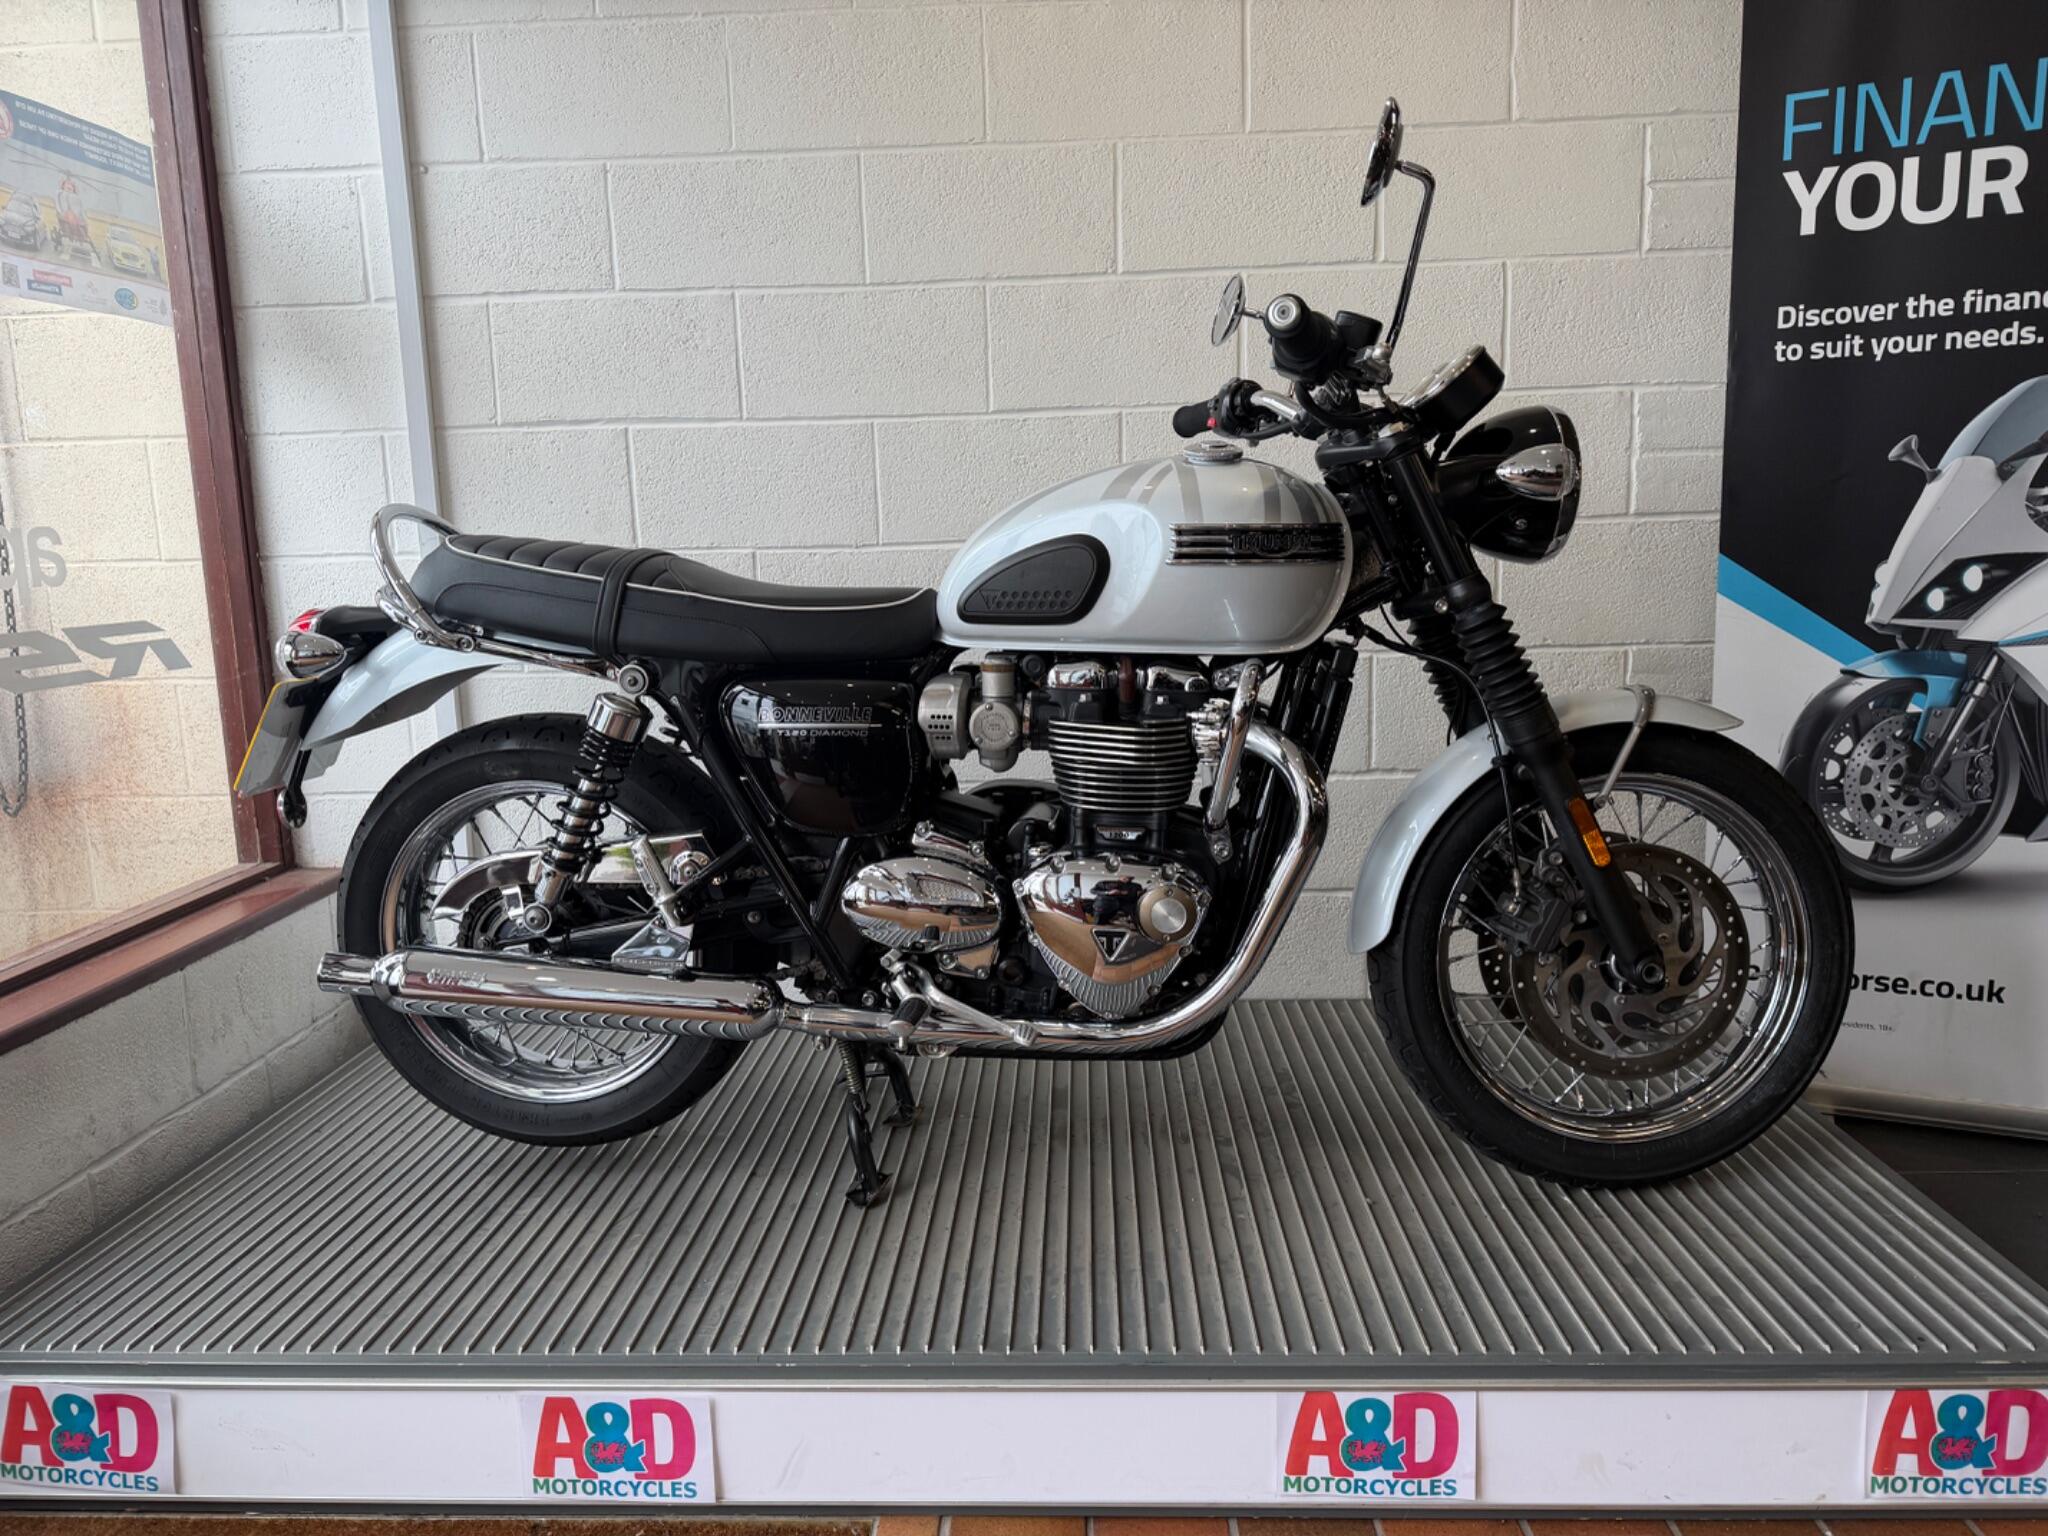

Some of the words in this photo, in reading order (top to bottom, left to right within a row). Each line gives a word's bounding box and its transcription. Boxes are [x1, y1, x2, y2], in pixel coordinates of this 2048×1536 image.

[1782, 57, 2048, 161] FINAN
[1782, 145, 2029, 236] YOUR
[1777, 301, 1899, 329] Discover
[1906, 294, 1954, 319] the
[1775, 340, 1803, 362] to
[1810, 333, 1864, 360] suit
[1871, 335, 1938, 361] your
[1945, 321, 2044, 350] needs.
[759, 707, 872, 722] BONNEVILLE
[0, 1385, 159, 1473] A&D
[533, 1396, 696, 1480] A&D
[1285, 1391, 1459, 1479] A&D
[1872, 1388, 2048, 1477] A&D
[1, 1464, 159, 1492] MOTORCYCLES
[532, 1478, 698, 1498] MOTORCYCLES
[1283, 1476, 1457, 1496] MOTORCYCLES
[1870, 1476, 2047, 1495] MOTORCYCLES
